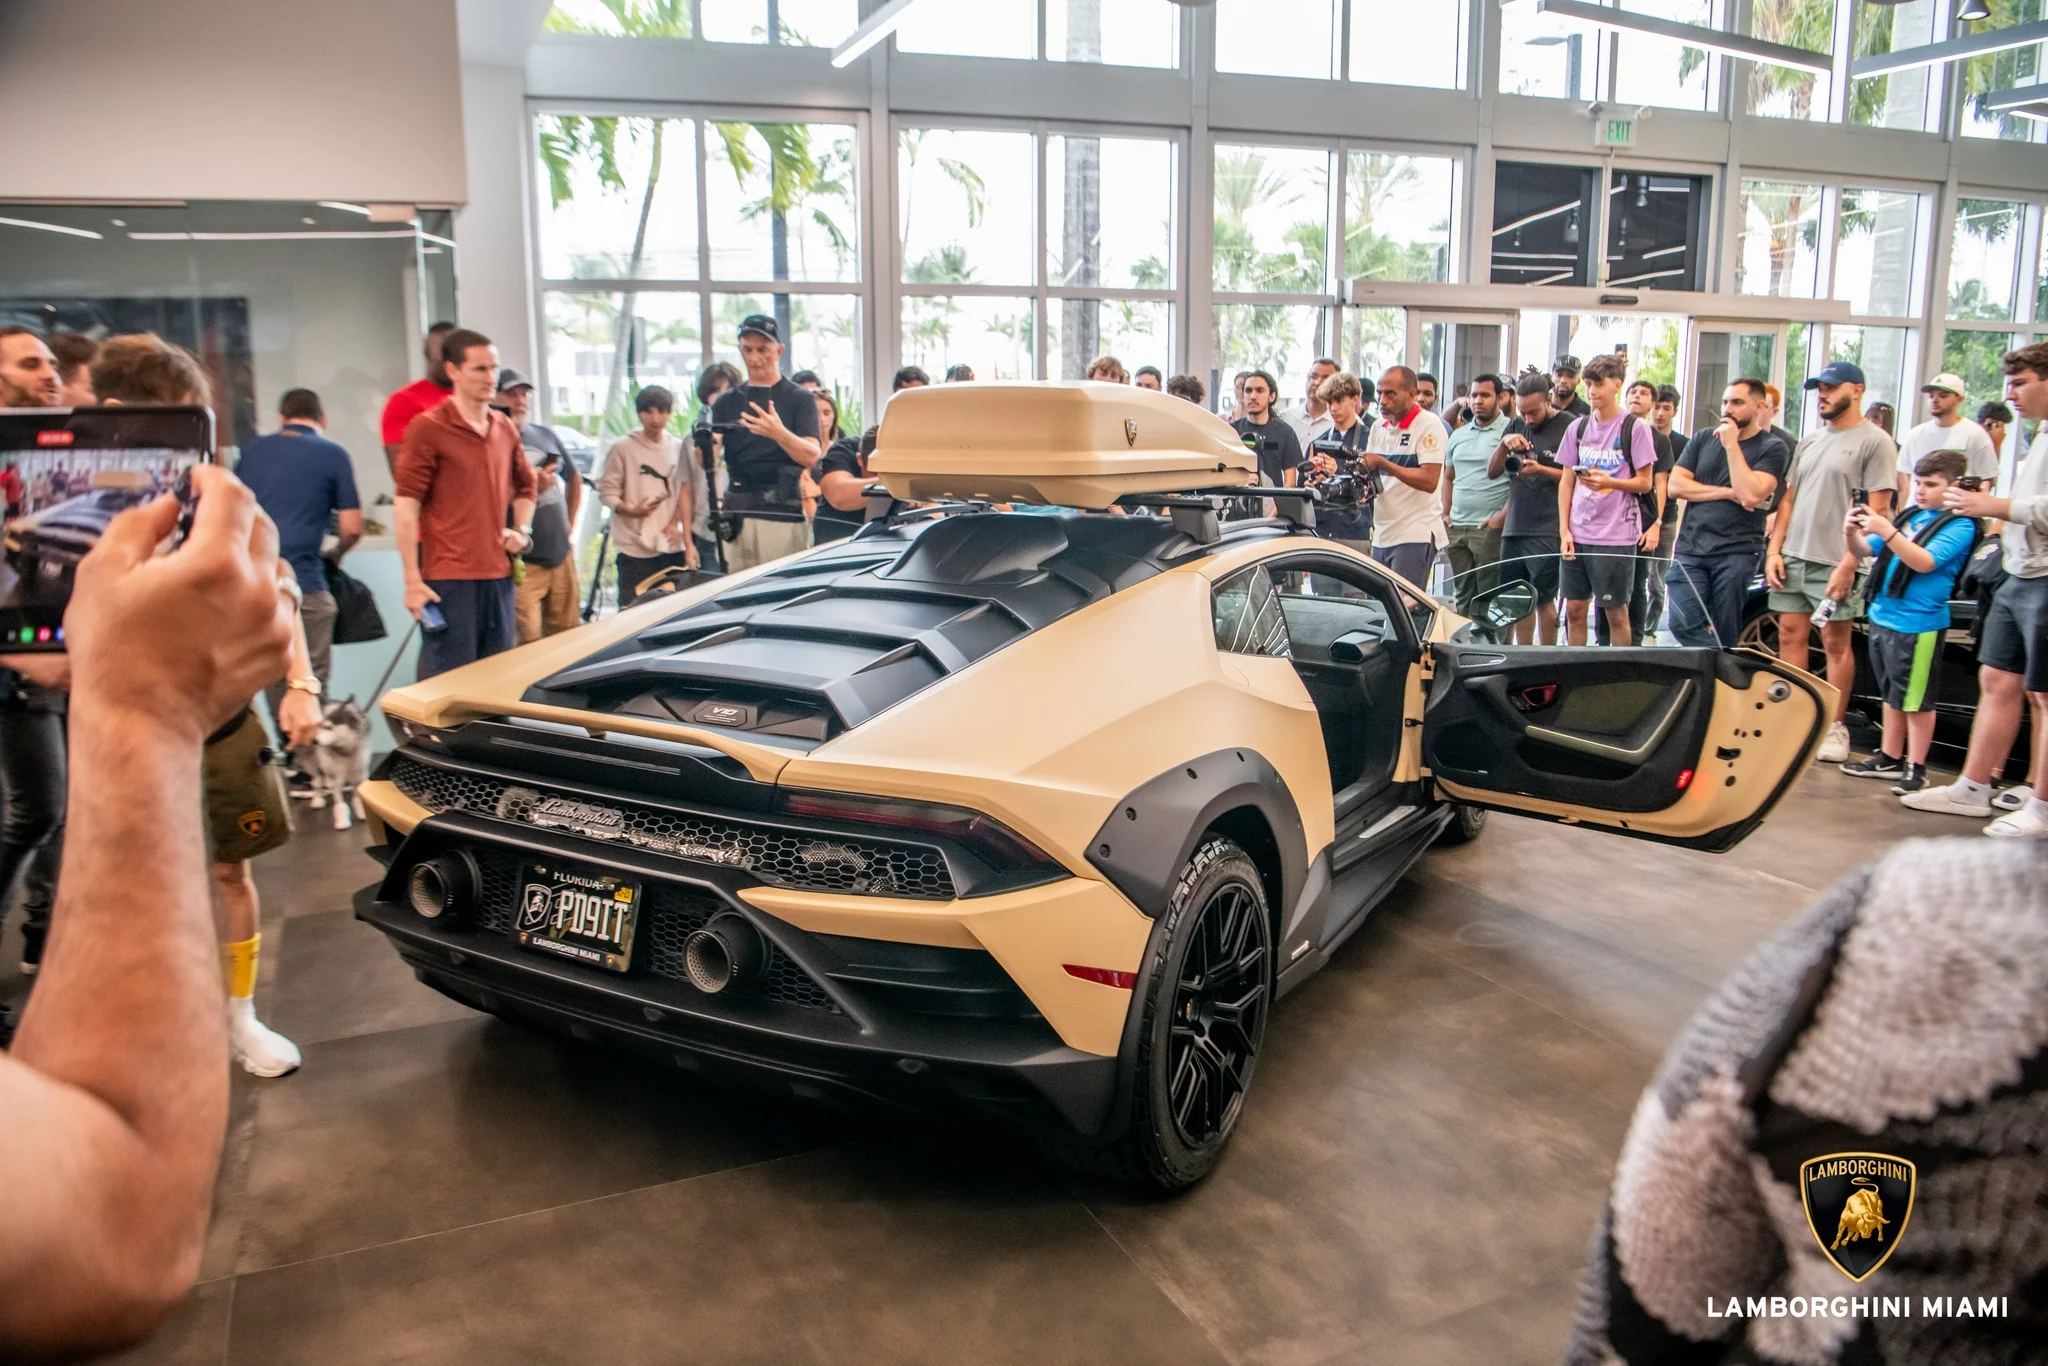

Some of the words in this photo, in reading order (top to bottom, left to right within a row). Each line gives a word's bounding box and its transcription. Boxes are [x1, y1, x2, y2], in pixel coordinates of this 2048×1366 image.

[1607, 119, 1632, 143] EXIT
[713, 707, 738, 715] V10
[538, 800, 619, 826] Lamborghini
[532, 937, 579, 955] LAMBORGHINI
[579, 949, 600, 961] MIAMI
